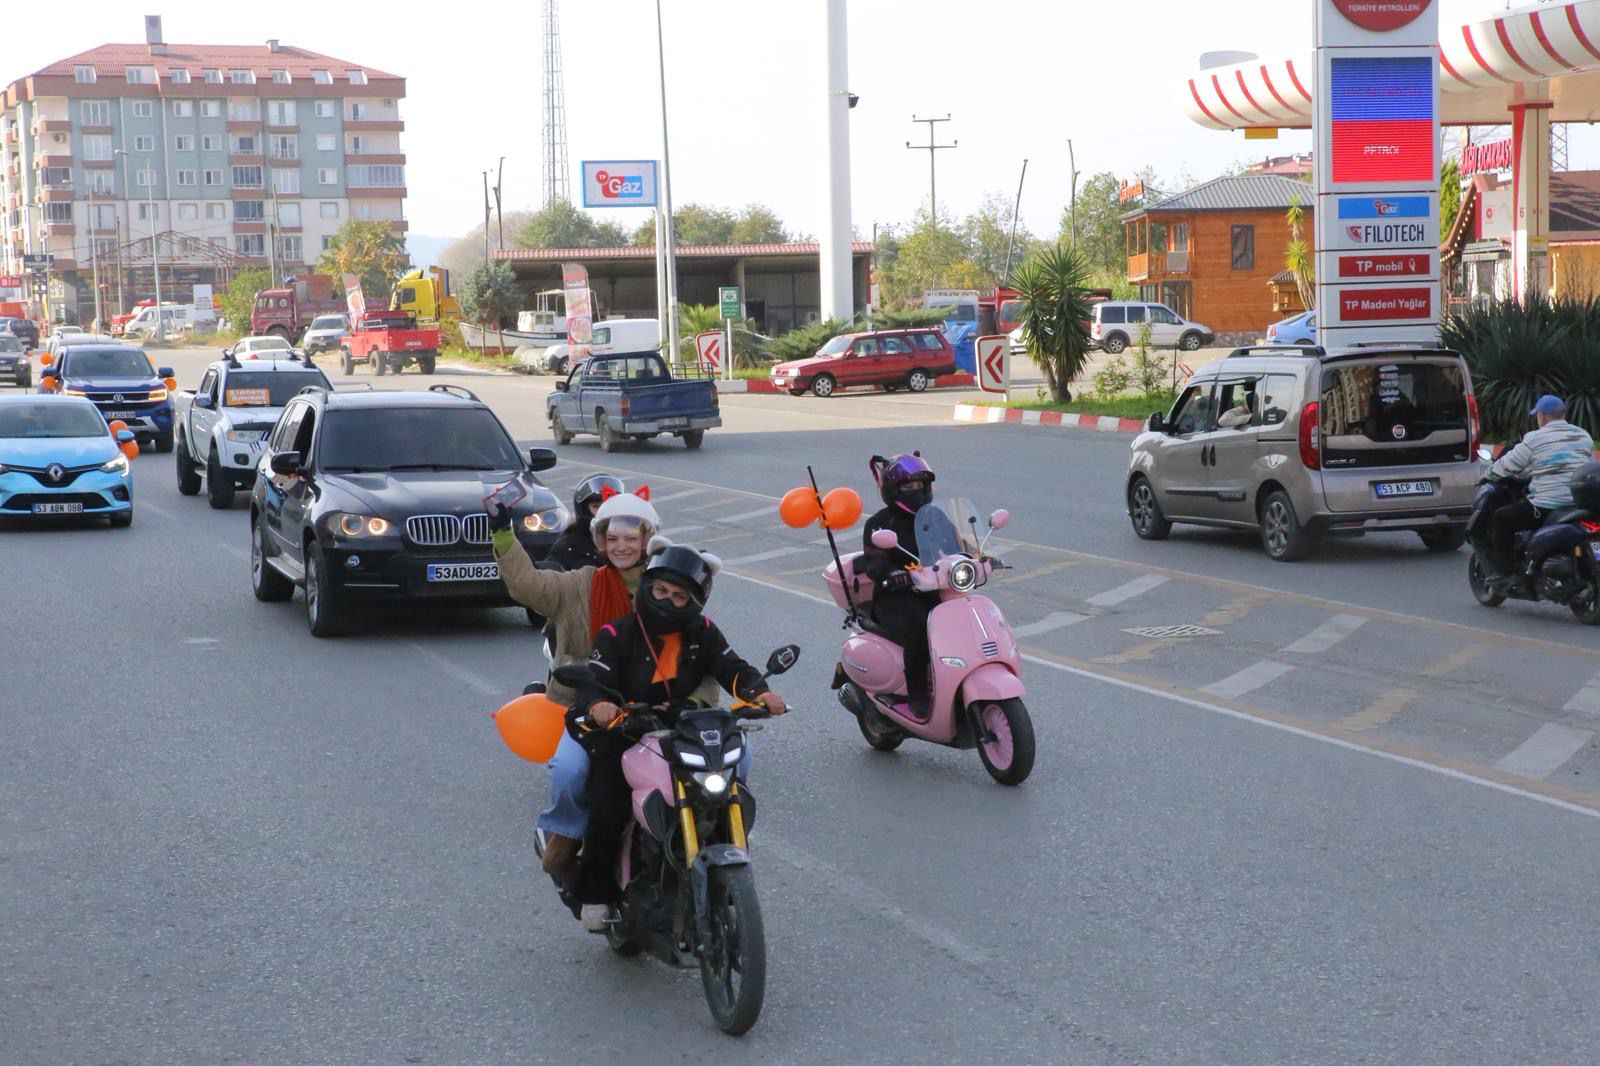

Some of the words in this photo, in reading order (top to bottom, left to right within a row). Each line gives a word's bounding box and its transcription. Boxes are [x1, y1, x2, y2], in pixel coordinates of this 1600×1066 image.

[1348, 4, 1377, 12] TÜRKİYE
[1379, 4, 1420, 12] PETROLLERİ
[609, 178, 641, 194] Gaz
[1364, 224, 1425, 243] FILOTECH
[1356, 261, 1373, 272] TP
[1375, 261, 1403, 271] mobil
[1345, 301, 1359, 310] TP
[1361, 299, 1396, 310] Madeni
[1398, 298, 1427, 311] Yağlar
[1382, 484, 1394, 495] 53
[1396, 483, 1411, 493] ACP
[37, 505, 47, 513] 53
[435, 567, 498, 578] 53ADU823
